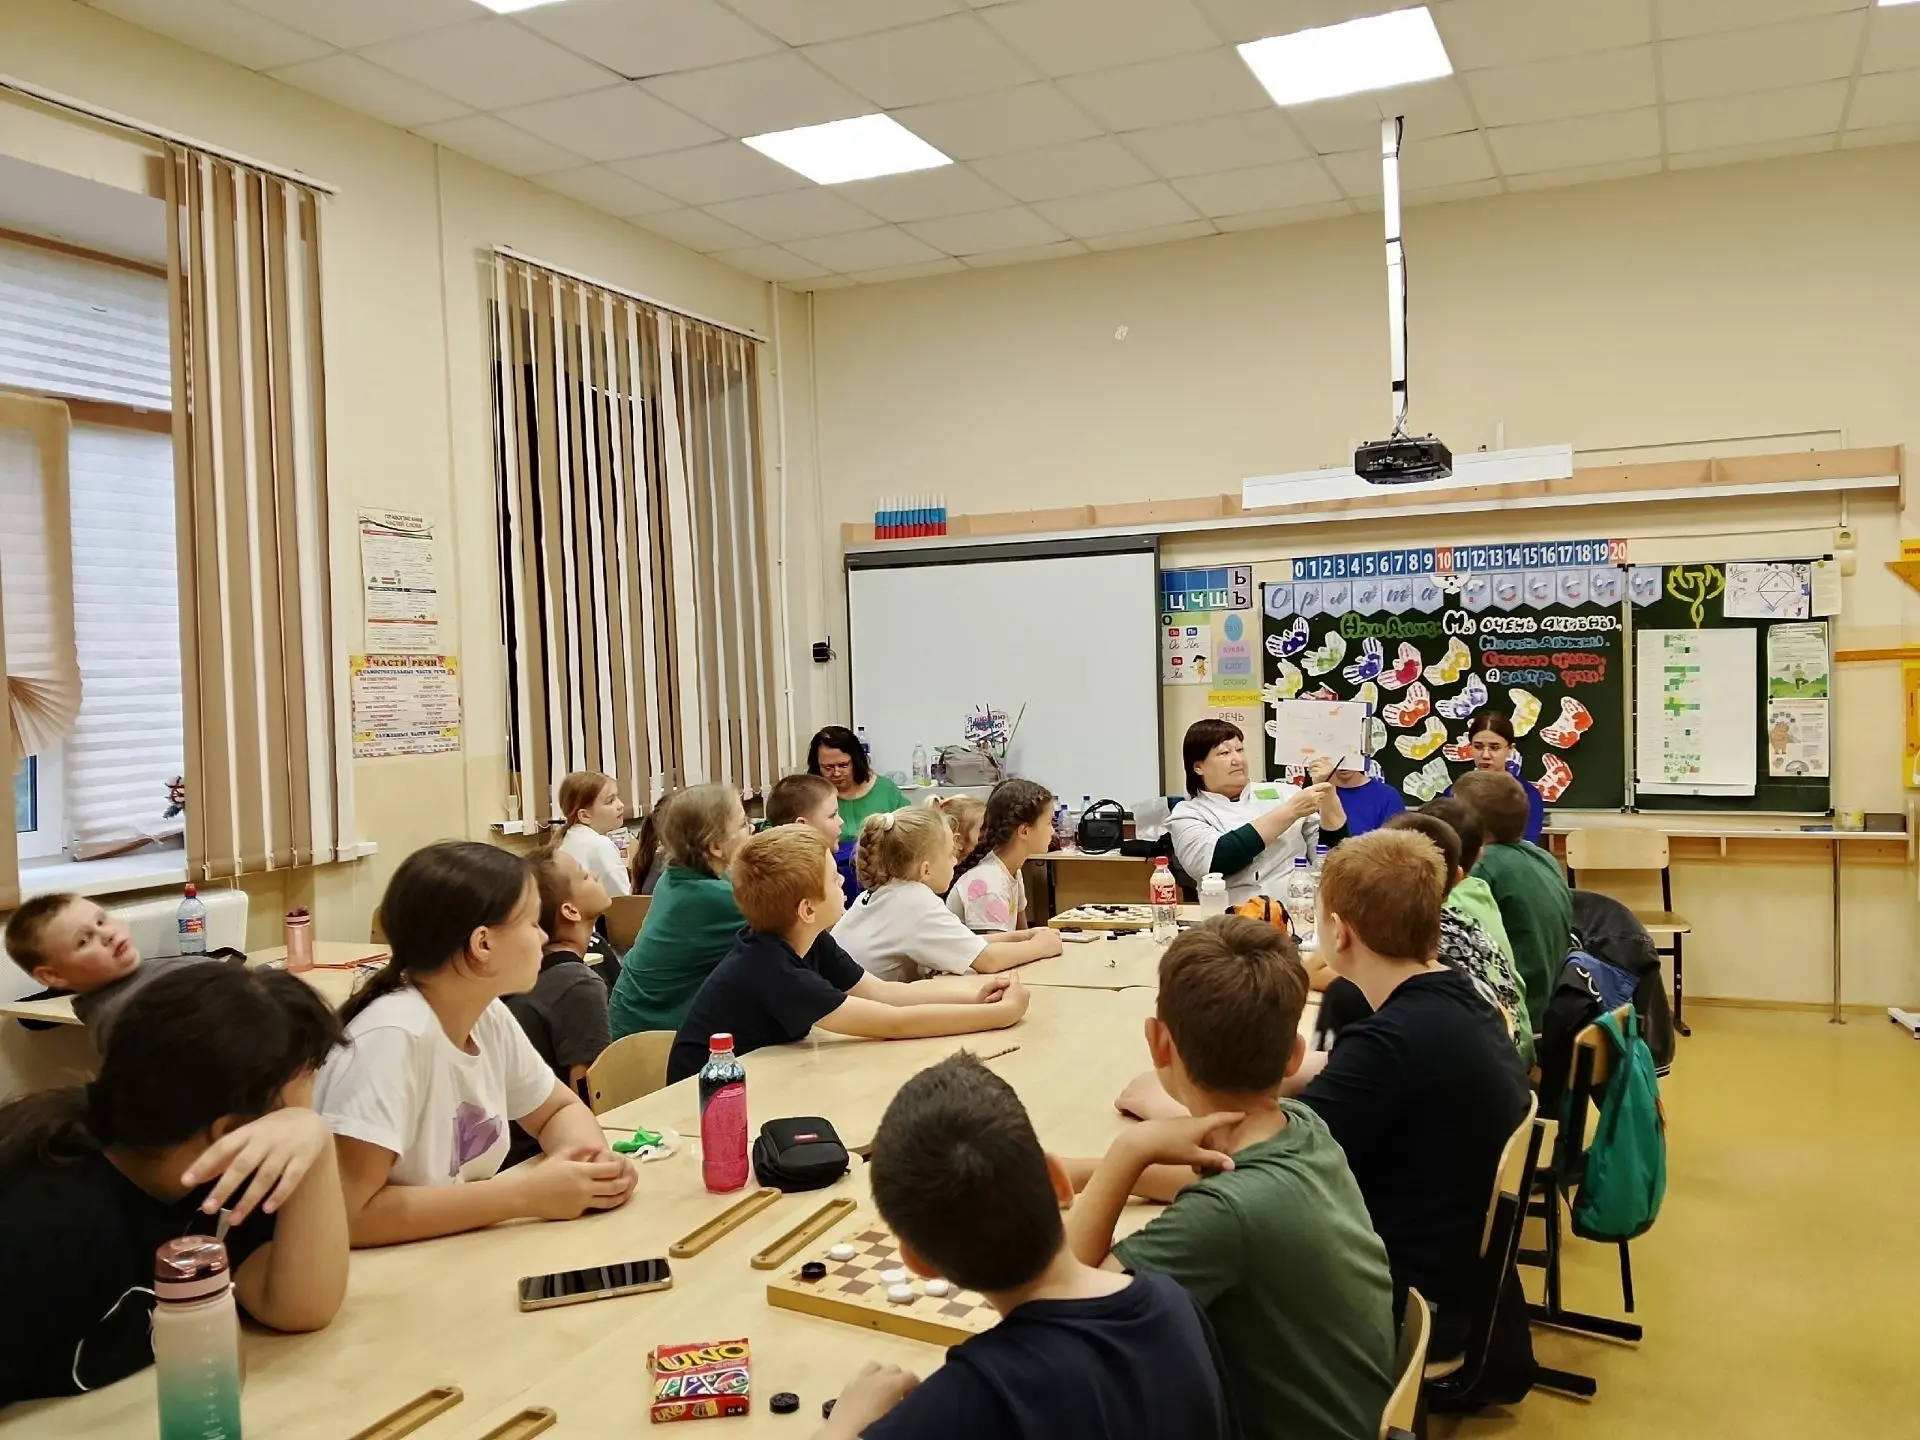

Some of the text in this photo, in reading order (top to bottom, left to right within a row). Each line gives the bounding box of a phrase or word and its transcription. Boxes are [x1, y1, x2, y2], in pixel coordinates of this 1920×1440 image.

[1294, 542, 1627, 578] 0 1 2 3 4 5 6 7 8 9 10 11 12 13 14 15 16 17 18 19 20
[1169, 593, 1186, 611] Ц
[1190, 592, 1204, 608] Ч
[1208, 590, 1229, 608] Щ
[372, 659, 438, 667] ЧАСТИ РЕЧИ
[1219, 712, 1245, 722] РЕЧЬ
[656, 1344, 749, 1373] UNO
